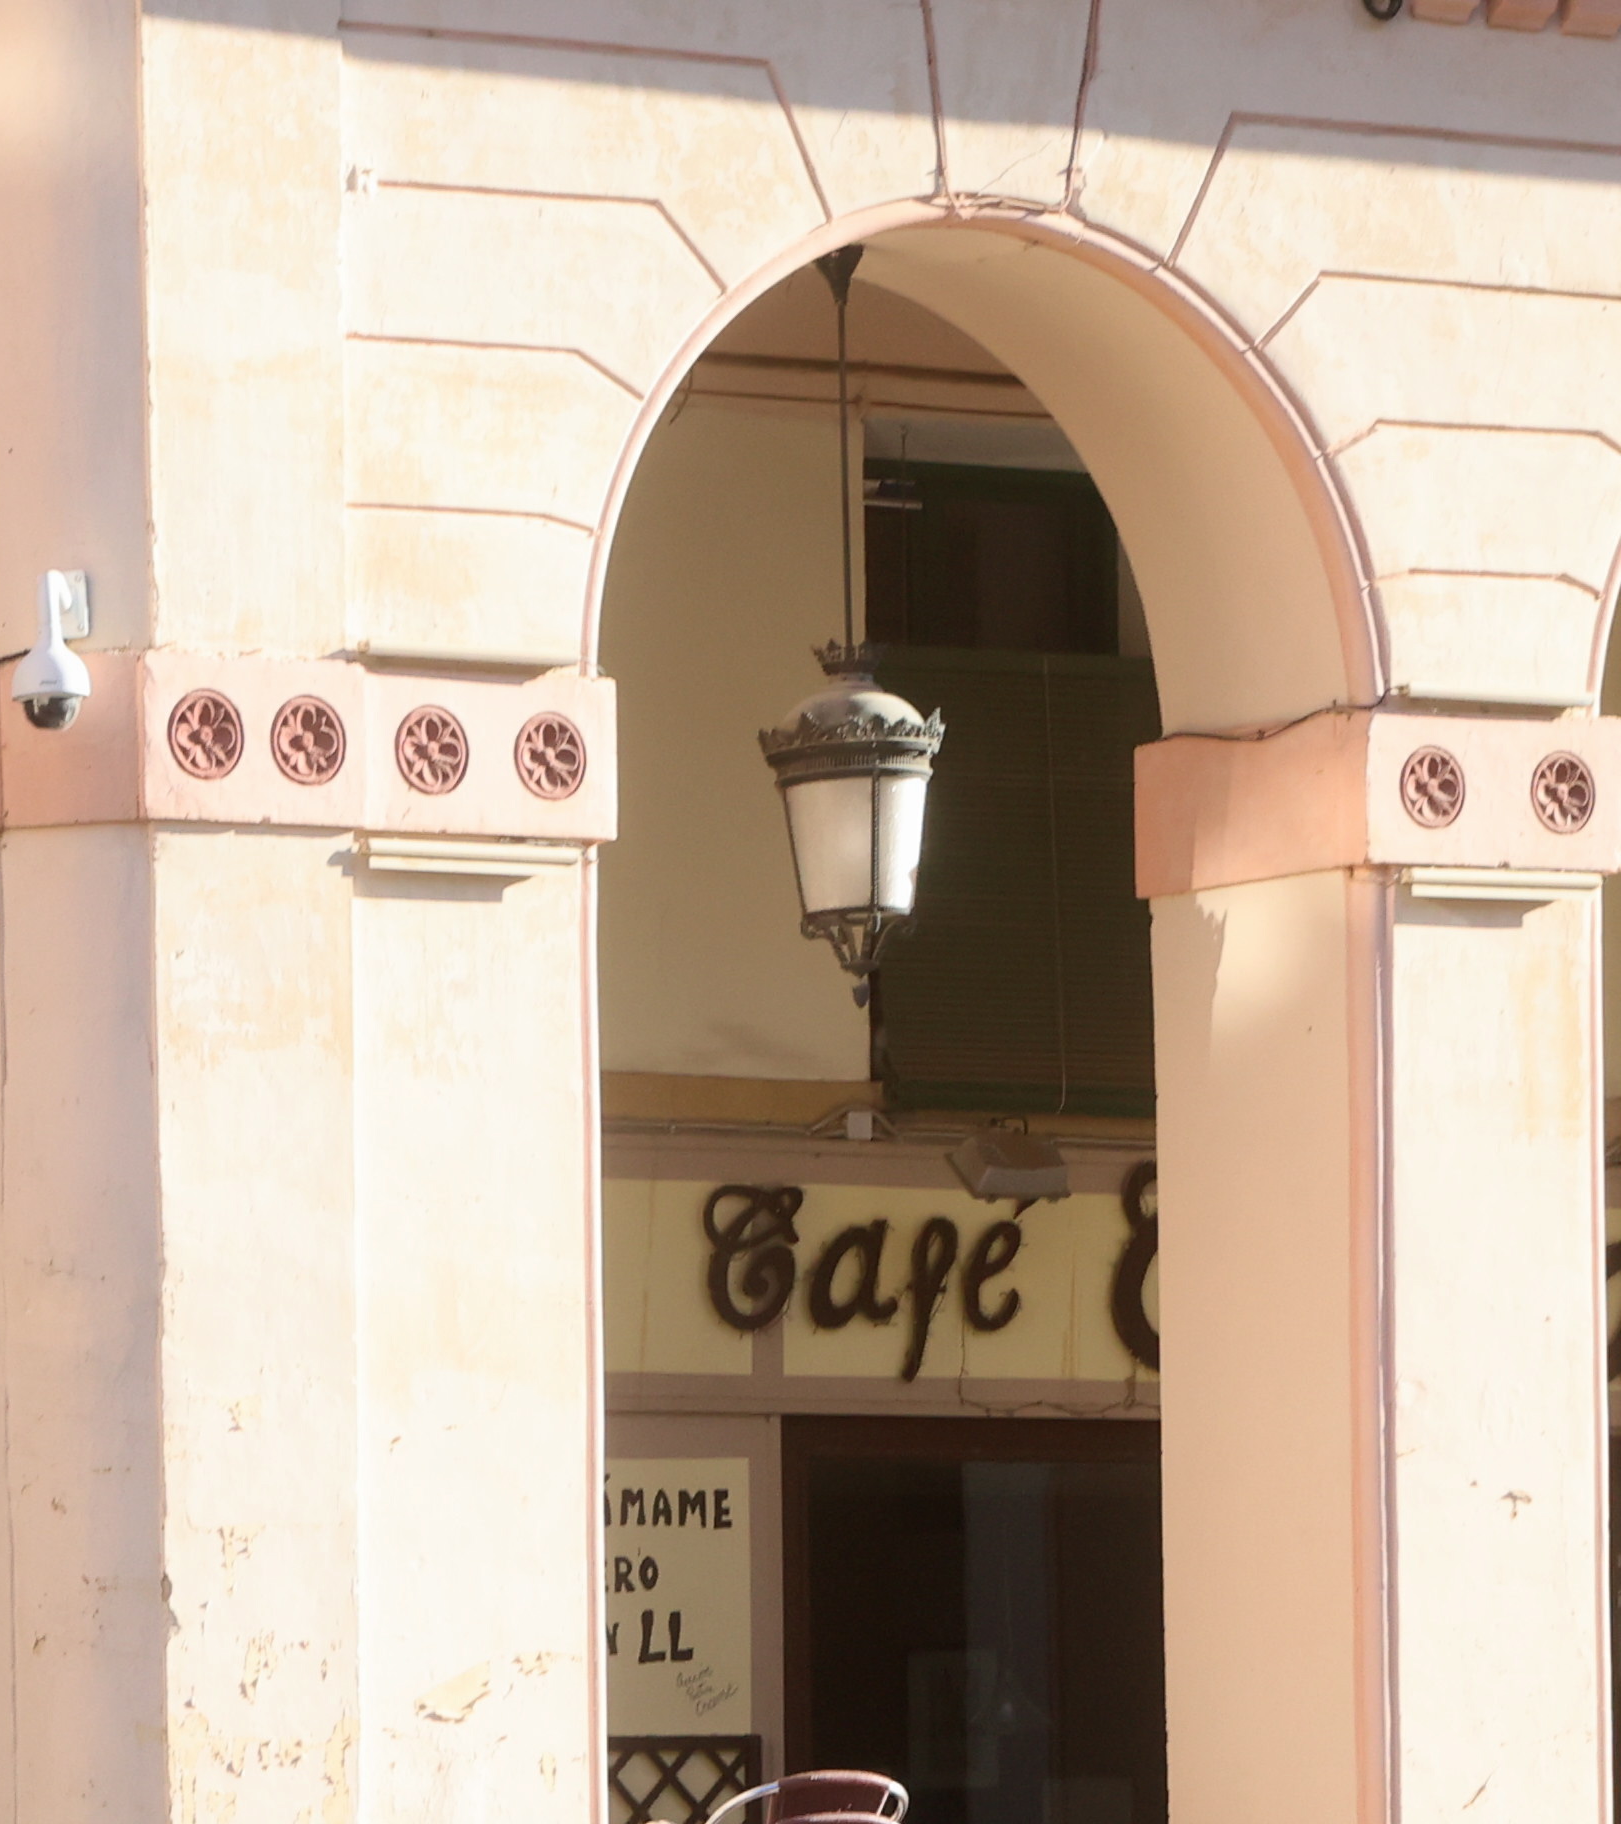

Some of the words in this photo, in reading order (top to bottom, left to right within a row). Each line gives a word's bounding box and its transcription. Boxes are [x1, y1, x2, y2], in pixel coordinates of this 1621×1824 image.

[701, 1184, 1039, 1384] Café
[606, 1555, 659, 1593] RO
[638, 1609, 695, 1665] LL
